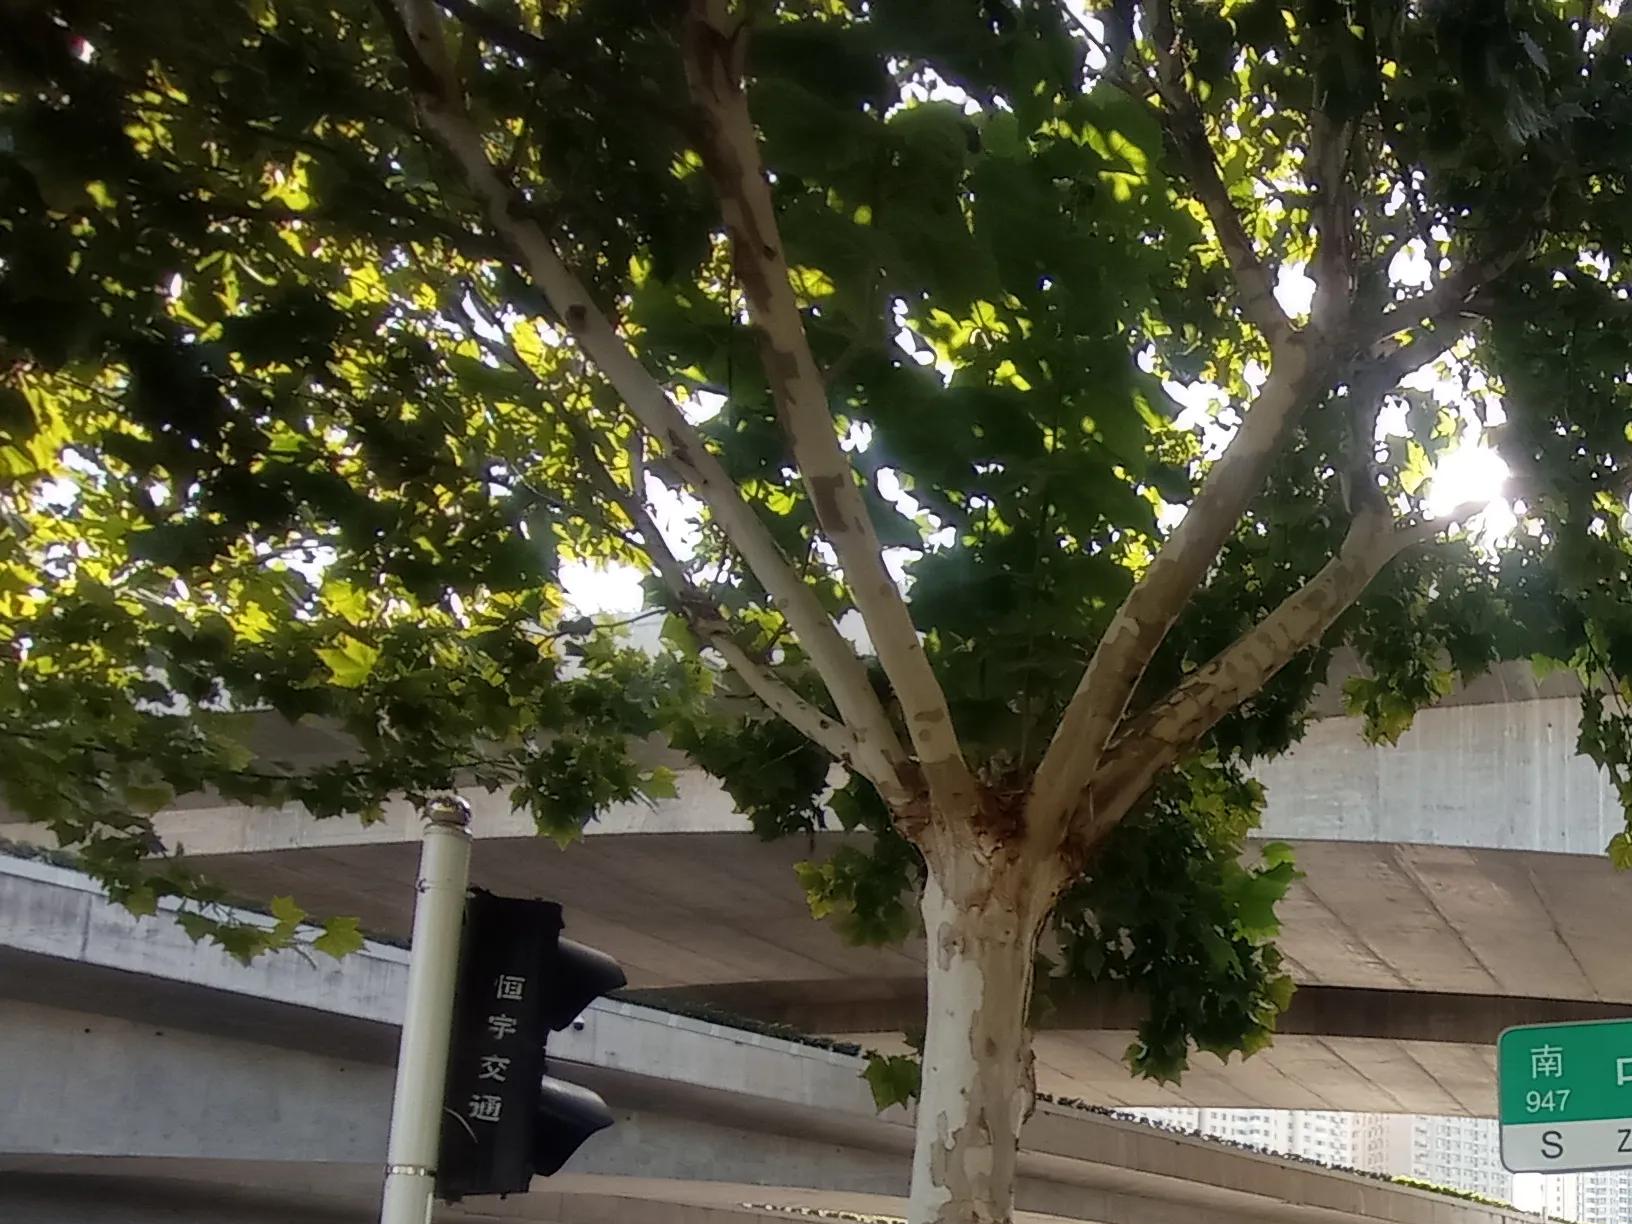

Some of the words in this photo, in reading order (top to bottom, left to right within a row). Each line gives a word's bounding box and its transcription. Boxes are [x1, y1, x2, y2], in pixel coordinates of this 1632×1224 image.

[468, 973, 526, 1122] 恒宇交通
[1530, 1044, 1563, 1079] 南
[1525, 1088, 1571, 1113] 947
[1540, 1130, 1564, 1160] S
